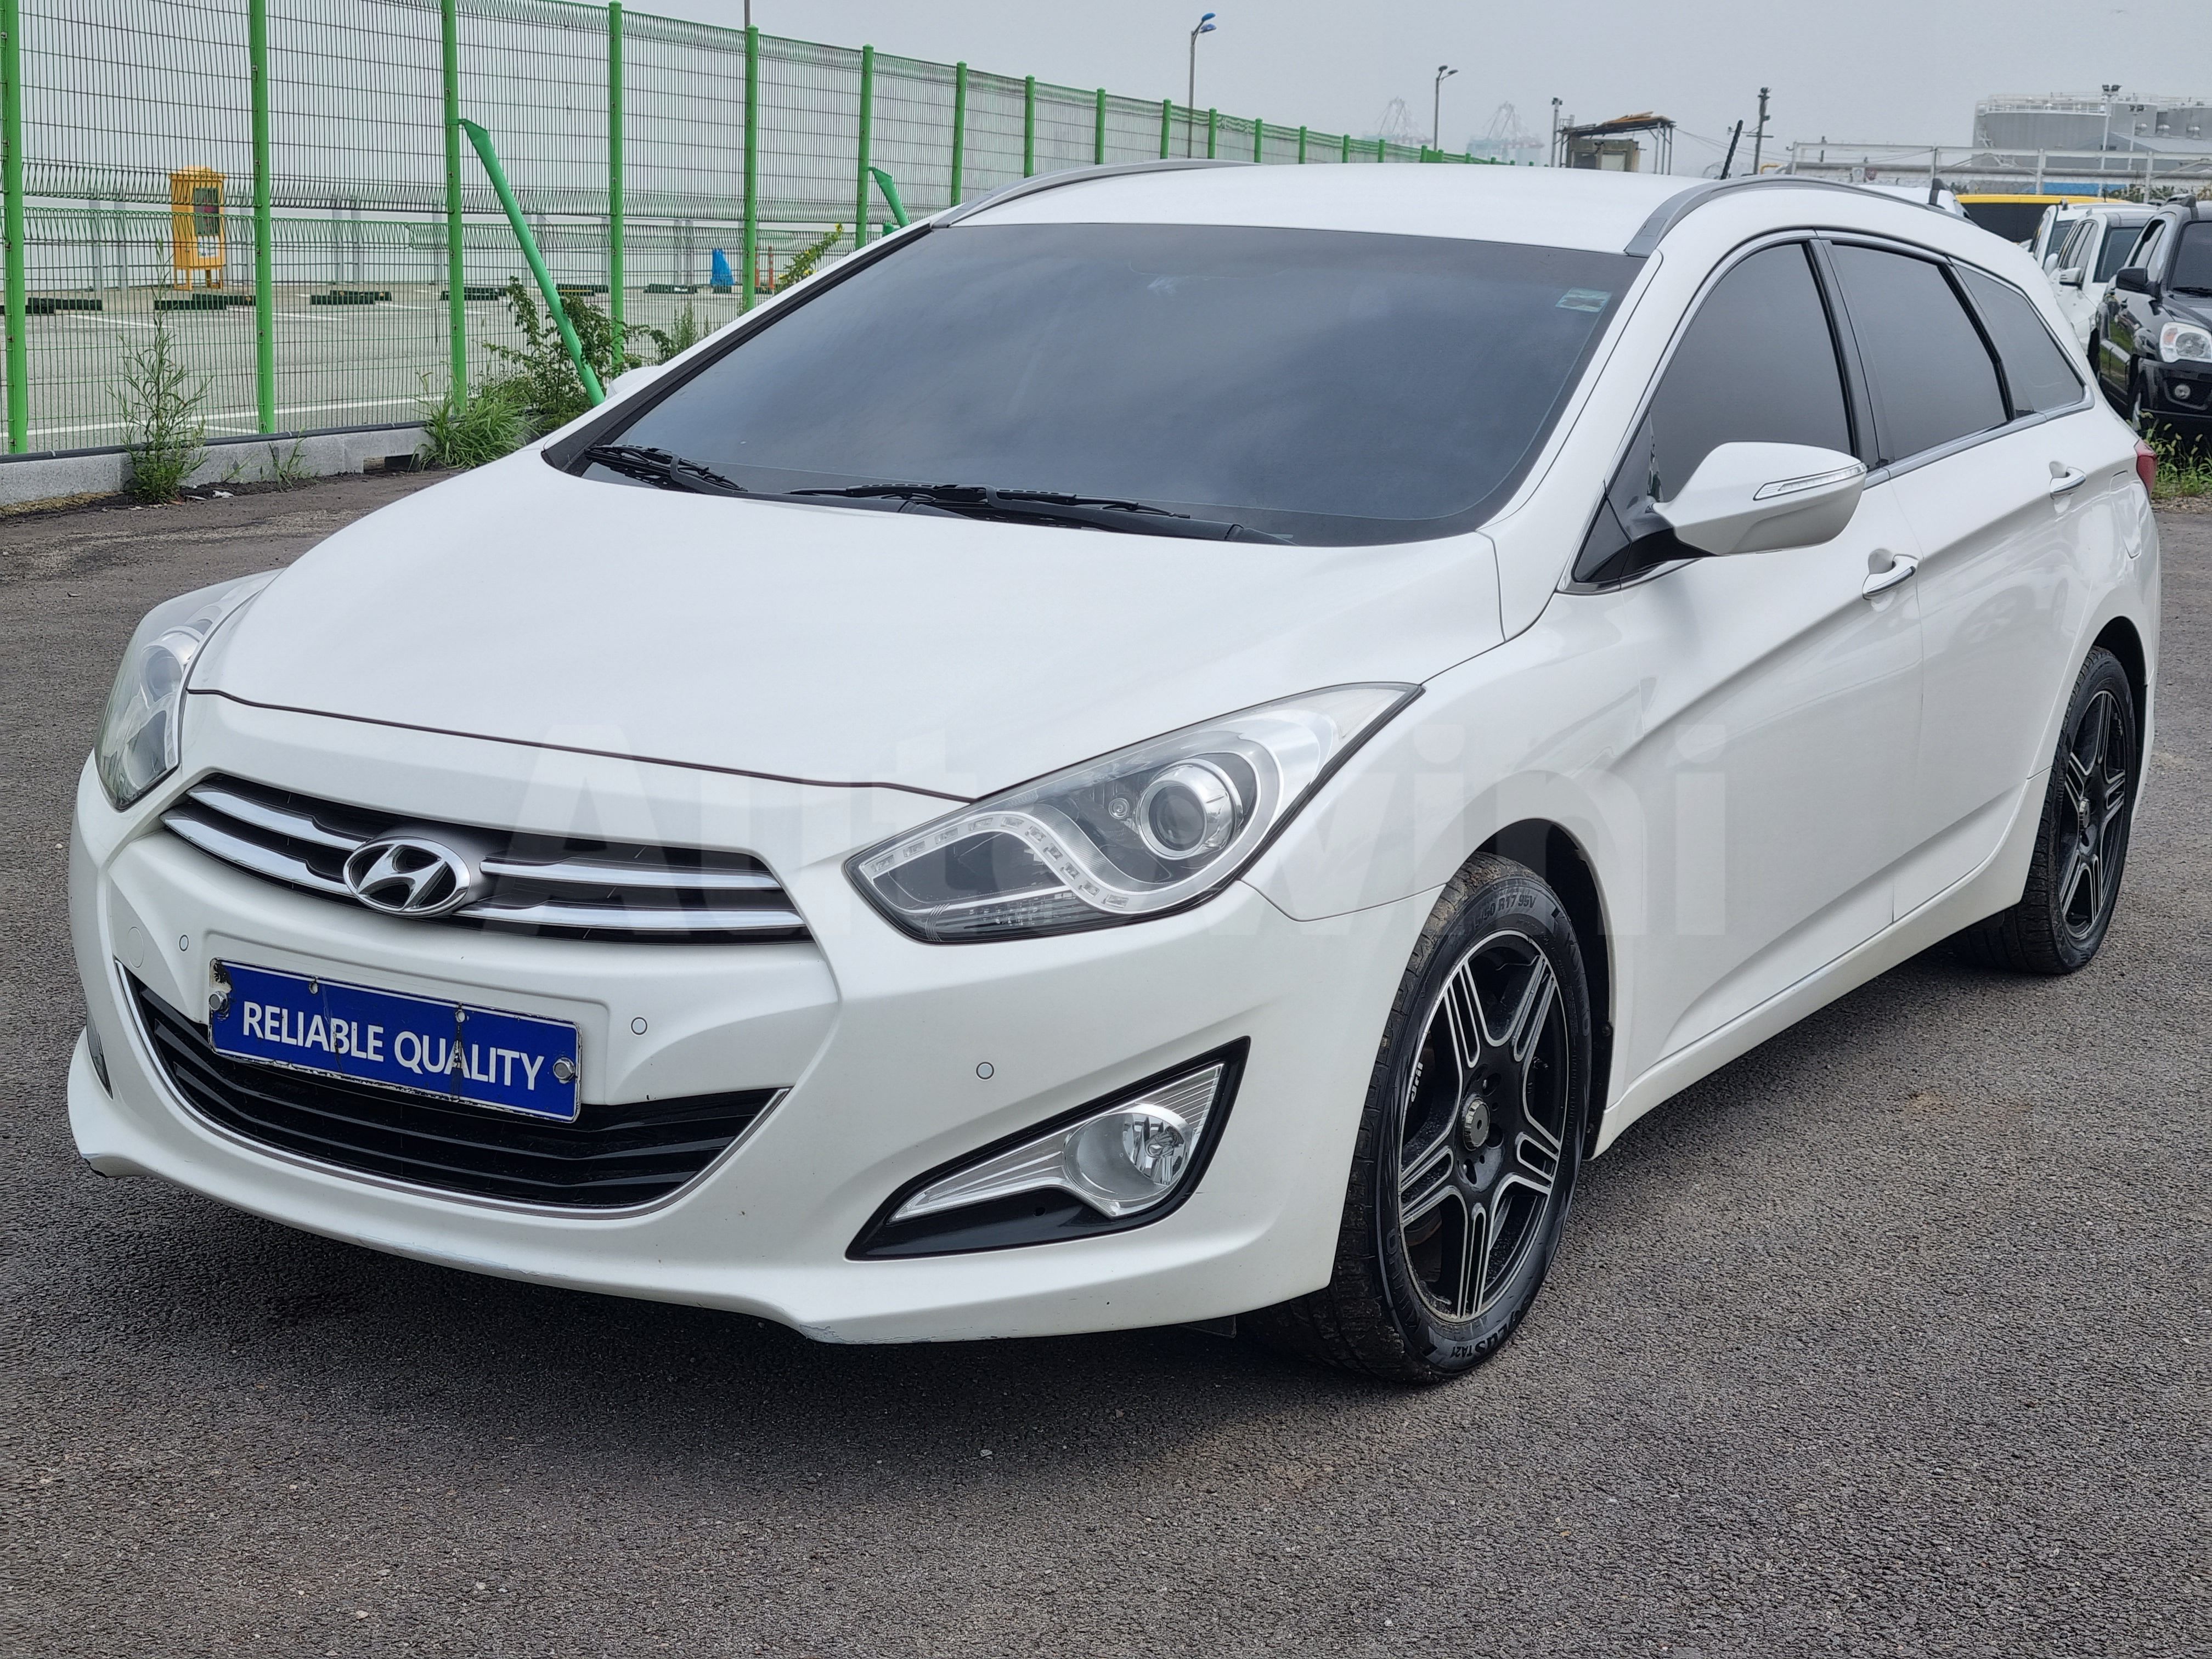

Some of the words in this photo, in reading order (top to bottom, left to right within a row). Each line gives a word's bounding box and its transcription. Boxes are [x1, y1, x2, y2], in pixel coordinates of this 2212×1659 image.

[242, 1001, 384, 1062] RELIABLE
[394, 1030, 545, 1091] QUALITY
[1449, 1345, 1473, 1358] TA21
